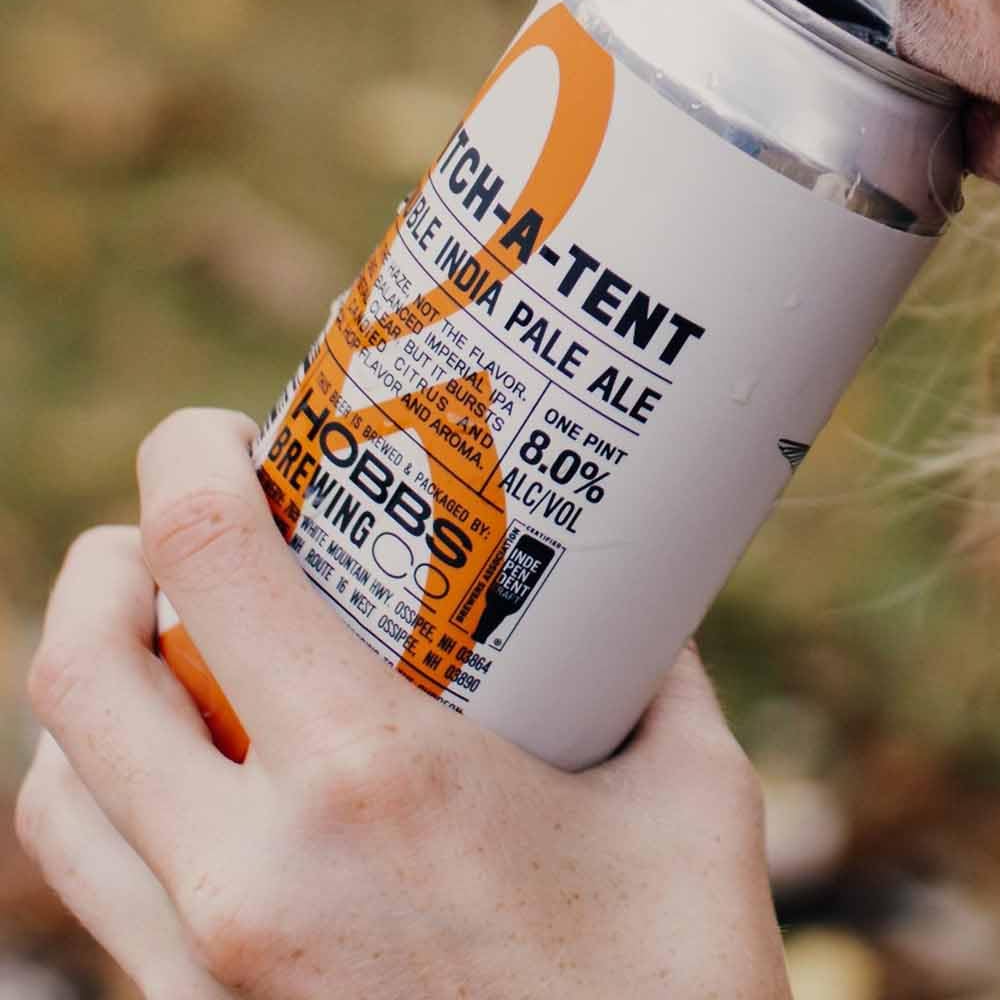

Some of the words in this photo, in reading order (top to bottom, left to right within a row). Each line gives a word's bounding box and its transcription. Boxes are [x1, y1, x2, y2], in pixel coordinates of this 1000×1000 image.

[405, 193, 442, 251] BLE
[434, 235, 503, 316] INDIA
[504, 300, 589, 379] PALE
[587, 366, 663, 424] ALE
[412, 293, 440, 322] NOT
[441, 318, 469, 349] THE
[468, 346, 528, 402] FLAVOR.
[358, 347, 403, 396] FLAVOR
[400, 393, 431, 422] AND
[429, 419, 484, 470] AROMA.
[394, 357, 449, 412] CITRUS
[456, 416, 494, 449] AND
[404, 339, 432, 368] BUT
[431, 364, 447, 381] IT
[446, 379, 505, 432] BURSTS
[424, 332, 485, 393] IMPERIAL
[488, 389, 514, 416] IPA
[291, 387, 473, 569] HOBBS
[329, 389, 352, 418] BEER
[351, 411, 363, 429] IS
[362, 425, 403, 466] BREWED
[403, 462, 413, 476] &
[415, 472, 471, 523] PACKAGED
[470, 517, 491, 540] BY:
[519, 429, 611, 504] 8.0%
[544, 408, 584, 440] ONE
[582, 432, 629, 465] PINT
[268, 426, 375, 549] BREWING
[372, 532, 449, 600] CO
[498, 467, 583, 534] ALC/VOL
[526, 525, 562, 549] CERTIFIED
[301, 515, 329, 547] WHITE
[326, 540, 369, 587] MOUNTAIN
[394, 600, 437, 642] OSSIPEE,
[437, 633, 457, 655] NH
[455, 646, 494, 675] 03864
[496, 572, 531, 598] DENT
[503, 560, 530, 583] PEN
[510, 548, 542, 573] INDE
[305, 548, 336, 582] ROUTE
[335, 576, 347, 594] 16
[349, 588, 376, 618] WEST
[377, 614, 419, 656] OSSIPEE,
[422, 650, 443, 671] NH
[444, 664, 482, 692] 03890
